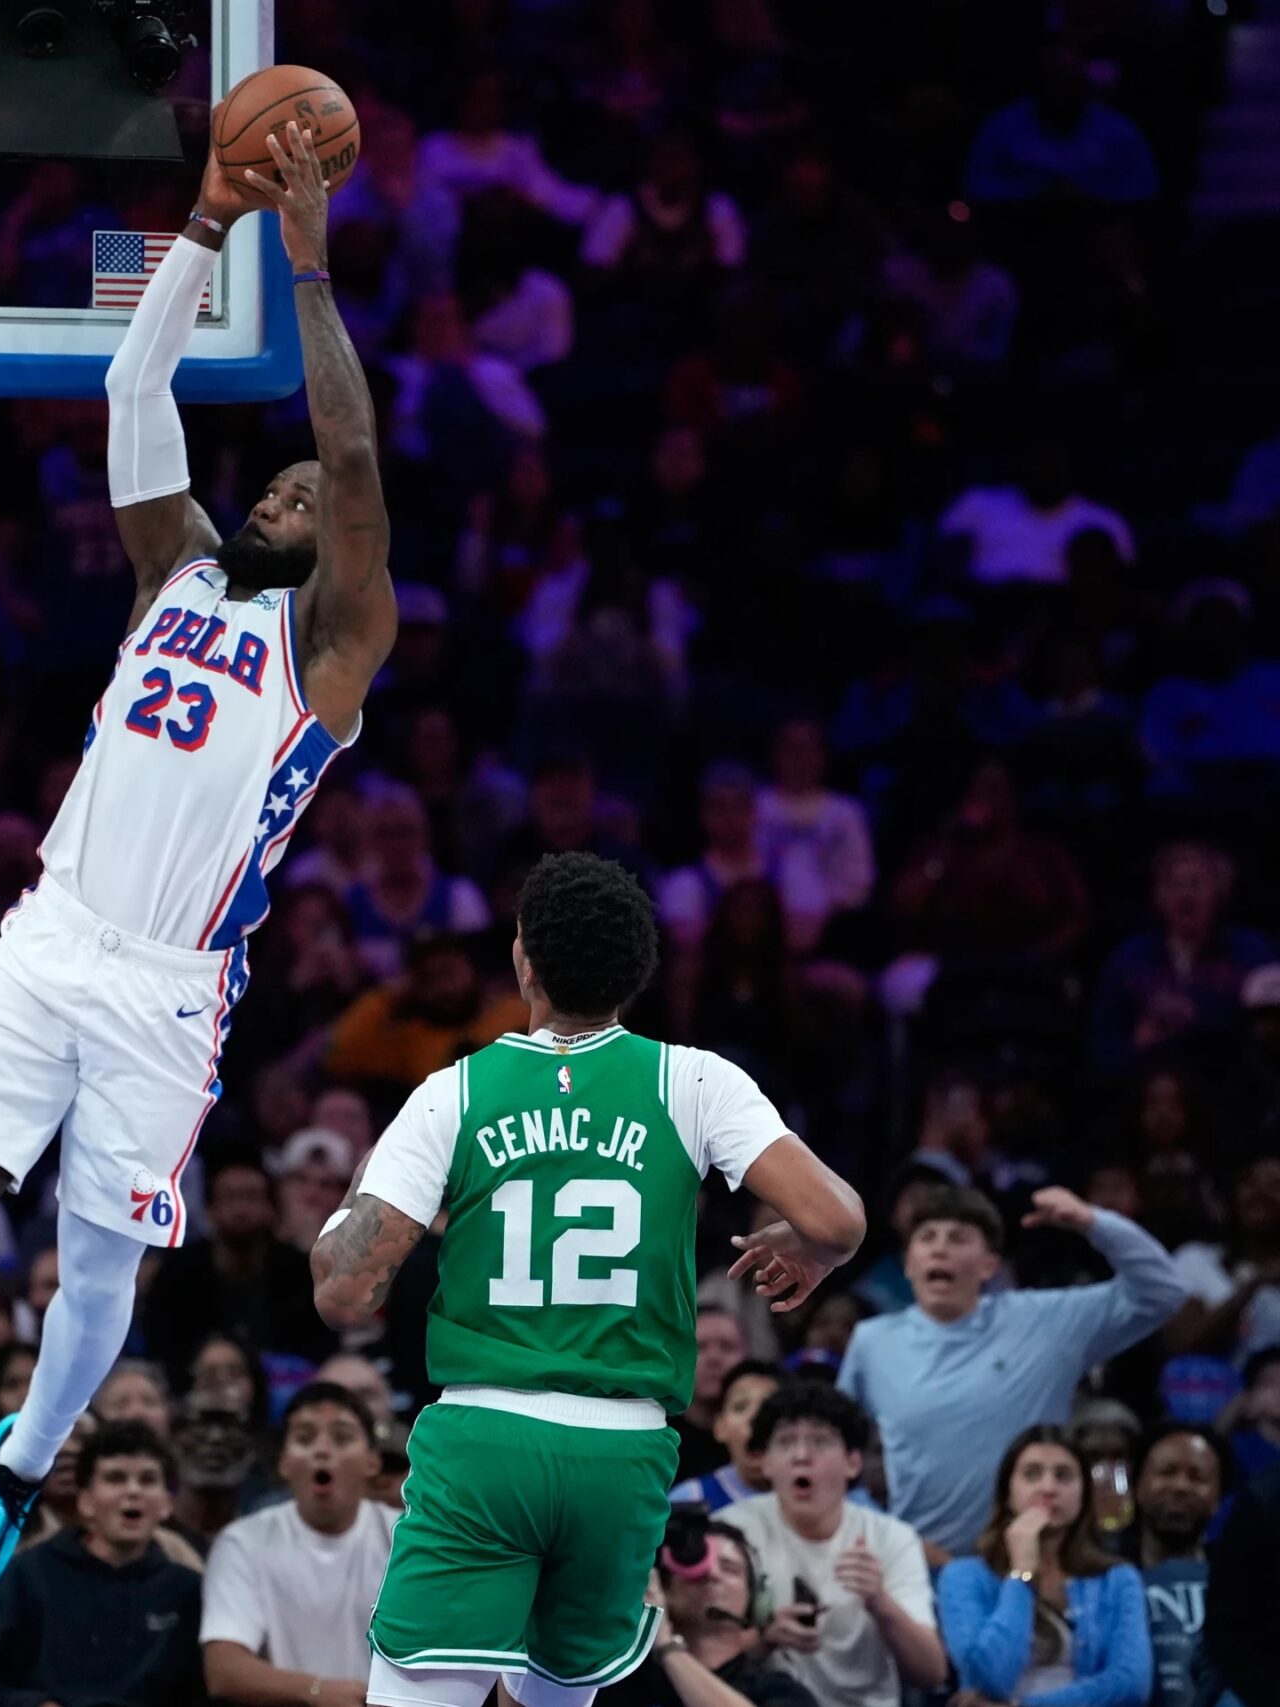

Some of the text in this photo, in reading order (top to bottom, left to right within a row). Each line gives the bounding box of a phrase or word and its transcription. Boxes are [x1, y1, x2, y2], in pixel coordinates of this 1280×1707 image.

[125, 666, 218, 752] 23
[552, 1035, 576, 1045] NIKE
[476, 1107, 648, 1172] CENAC JR.
[131, 1187, 174, 1227] 76
[488, 1179, 642, 1307] 12
[1147, 1583, 1207, 1634] NJ
